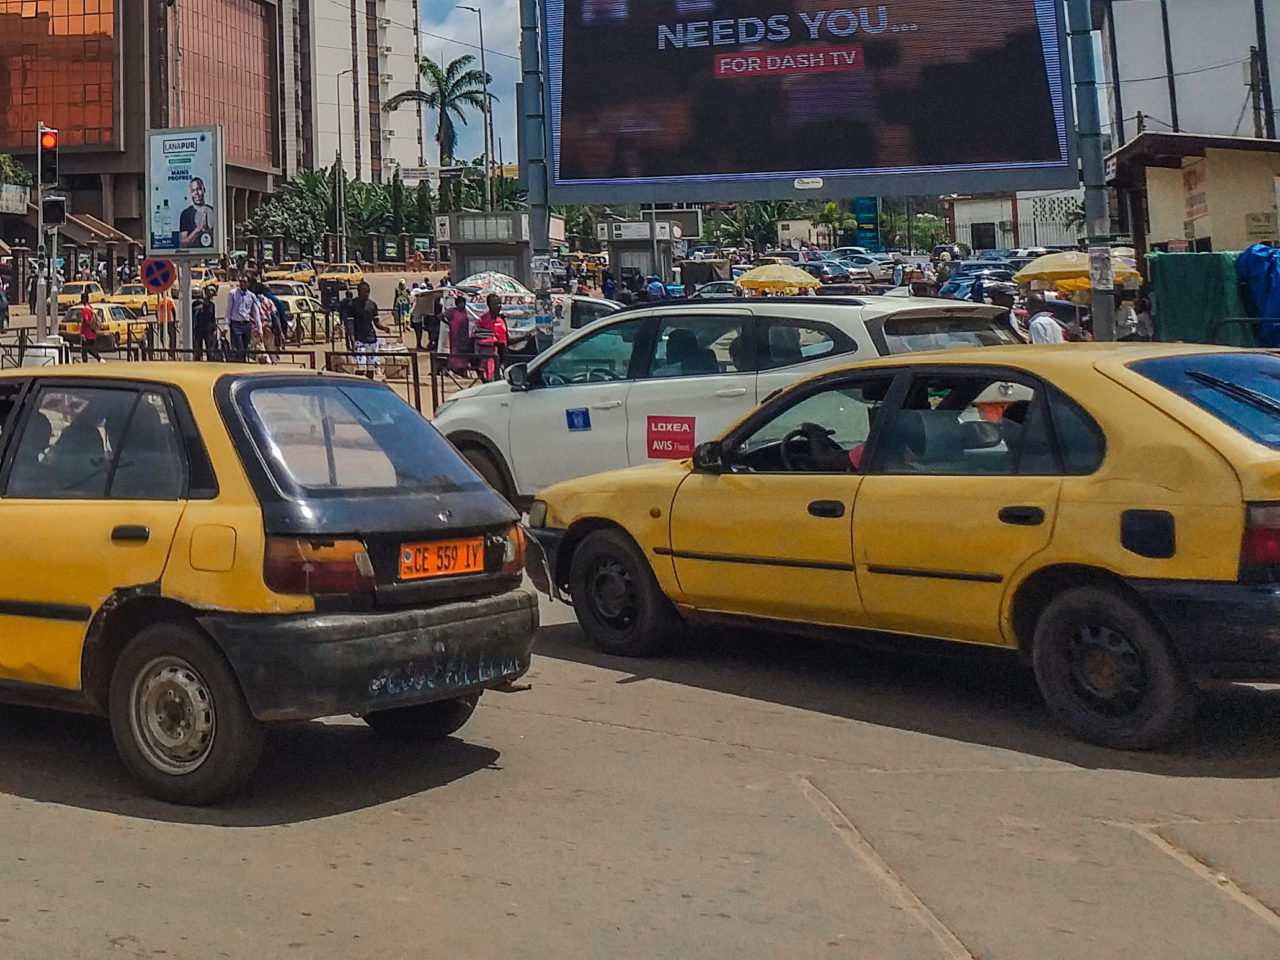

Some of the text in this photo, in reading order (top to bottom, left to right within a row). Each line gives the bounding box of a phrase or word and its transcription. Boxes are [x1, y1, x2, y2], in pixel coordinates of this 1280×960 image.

[658, 6, 919, 50] NEEDS YOU...
[720, 50, 857, 74] FOR DASH TV
[164, 142, 196, 150] LANAPUR
[651, 423, 690, 432] LOXEA
[652, 440, 690, 451] AVIS Fleet
[414, 543, 482, 572] CE 559 IY
